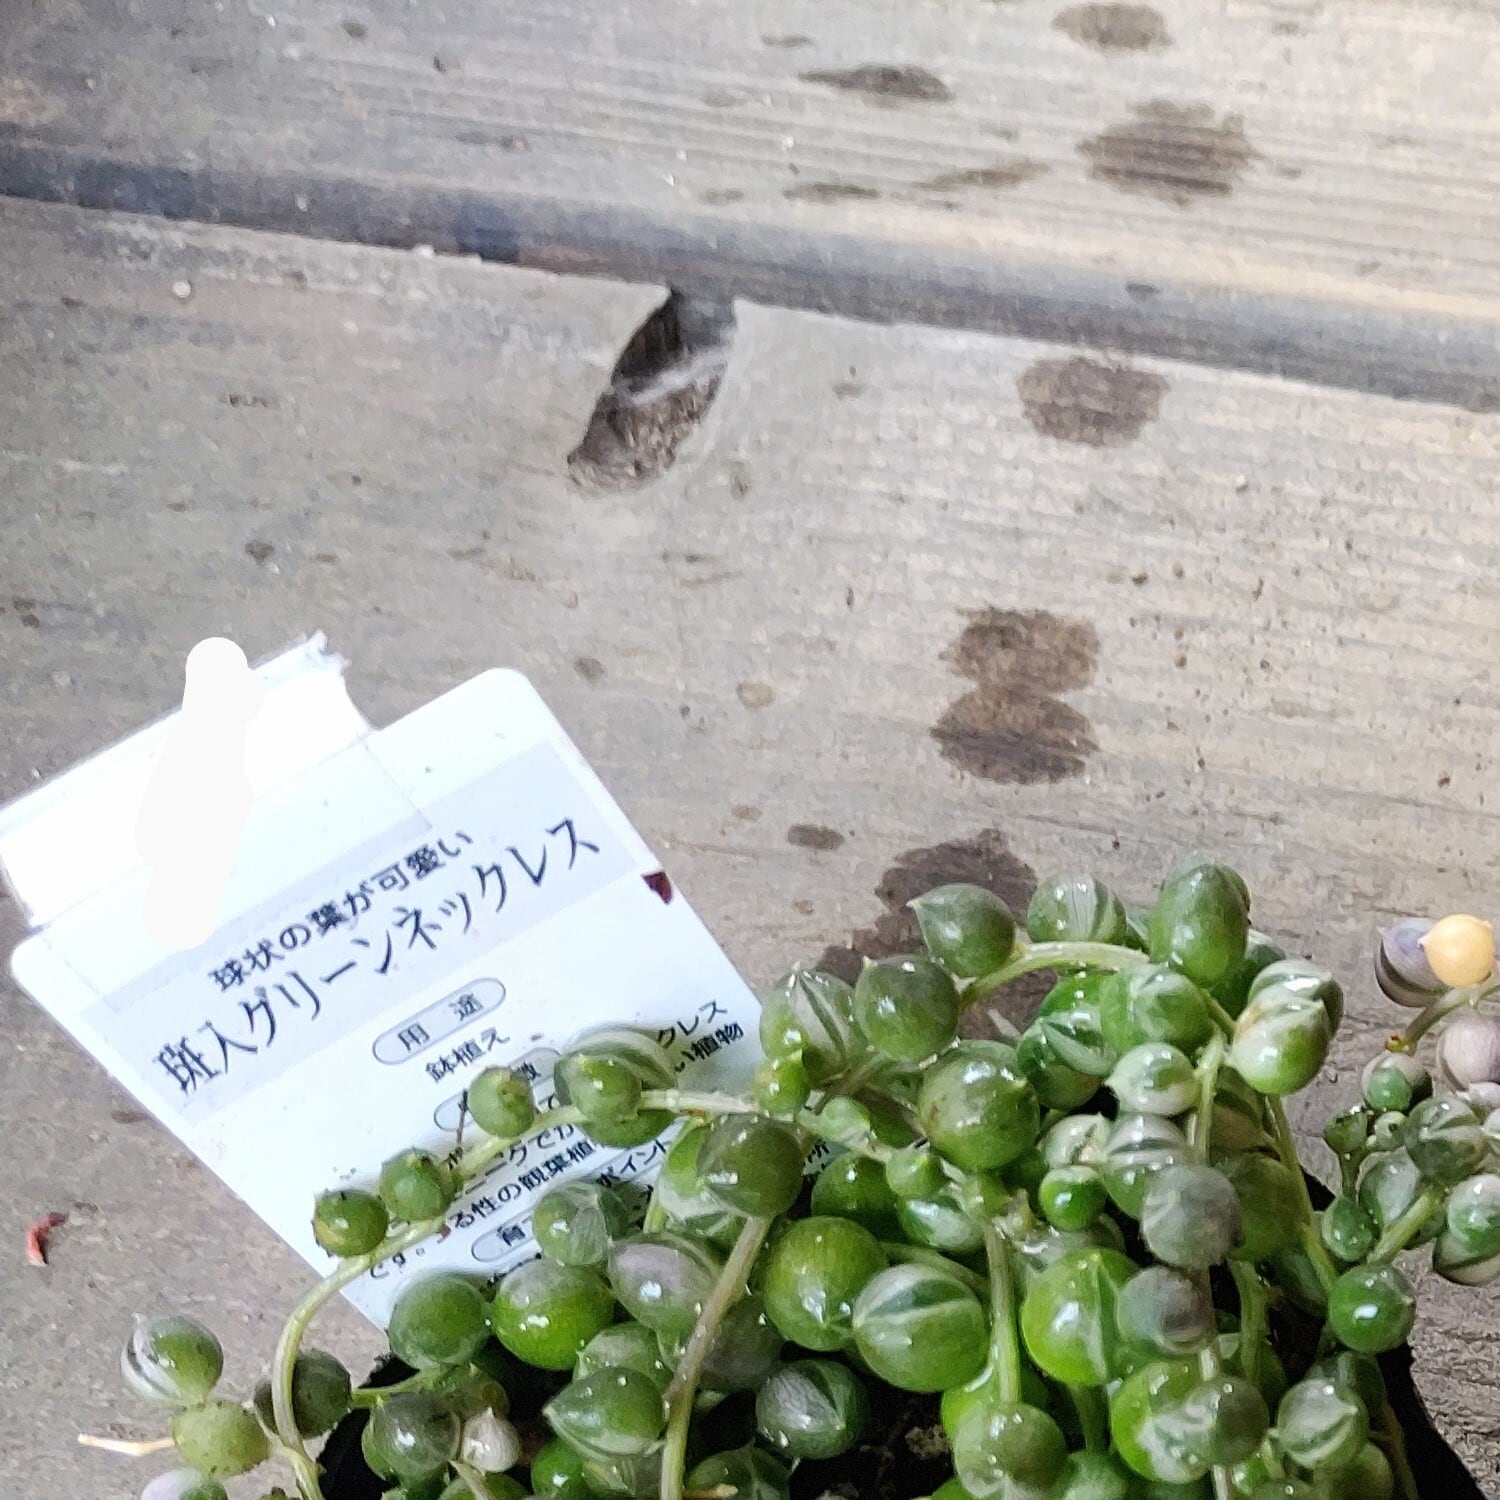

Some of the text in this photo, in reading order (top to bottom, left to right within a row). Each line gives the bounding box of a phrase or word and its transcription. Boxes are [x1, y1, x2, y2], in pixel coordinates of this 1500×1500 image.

[152, 817, 600, 1097] 斑入グリーンネックレス
[209, 830, 474, 992] 球状の葉が可愛い
[424, 1026, 511, 1084] 鉢植え
